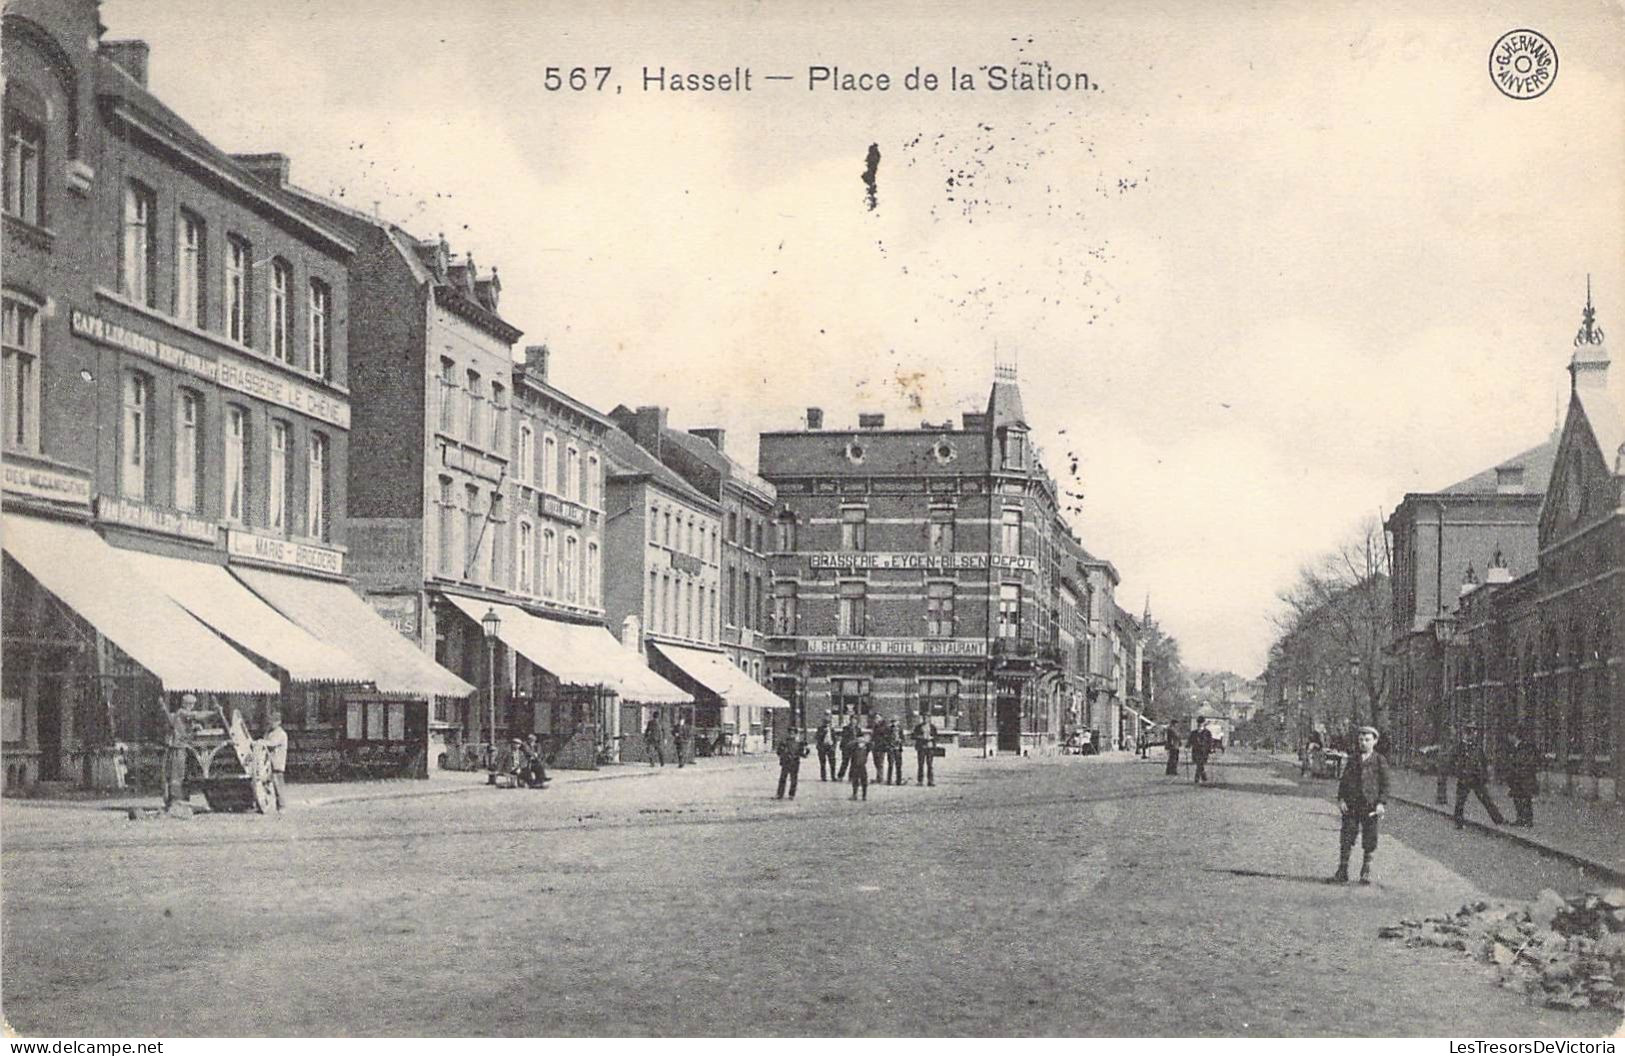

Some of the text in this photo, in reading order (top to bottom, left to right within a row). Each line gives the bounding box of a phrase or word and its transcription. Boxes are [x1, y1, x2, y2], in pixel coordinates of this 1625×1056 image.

[221, 362, 284, 402] BRASSERIE
[811, 554, 879, 568] BRASSERIE
[992, 553, 1035, 568] DEPOT
[886, 640, 917, 653] HOTEL
[922, 640, 984, 653] RESTAURANT
